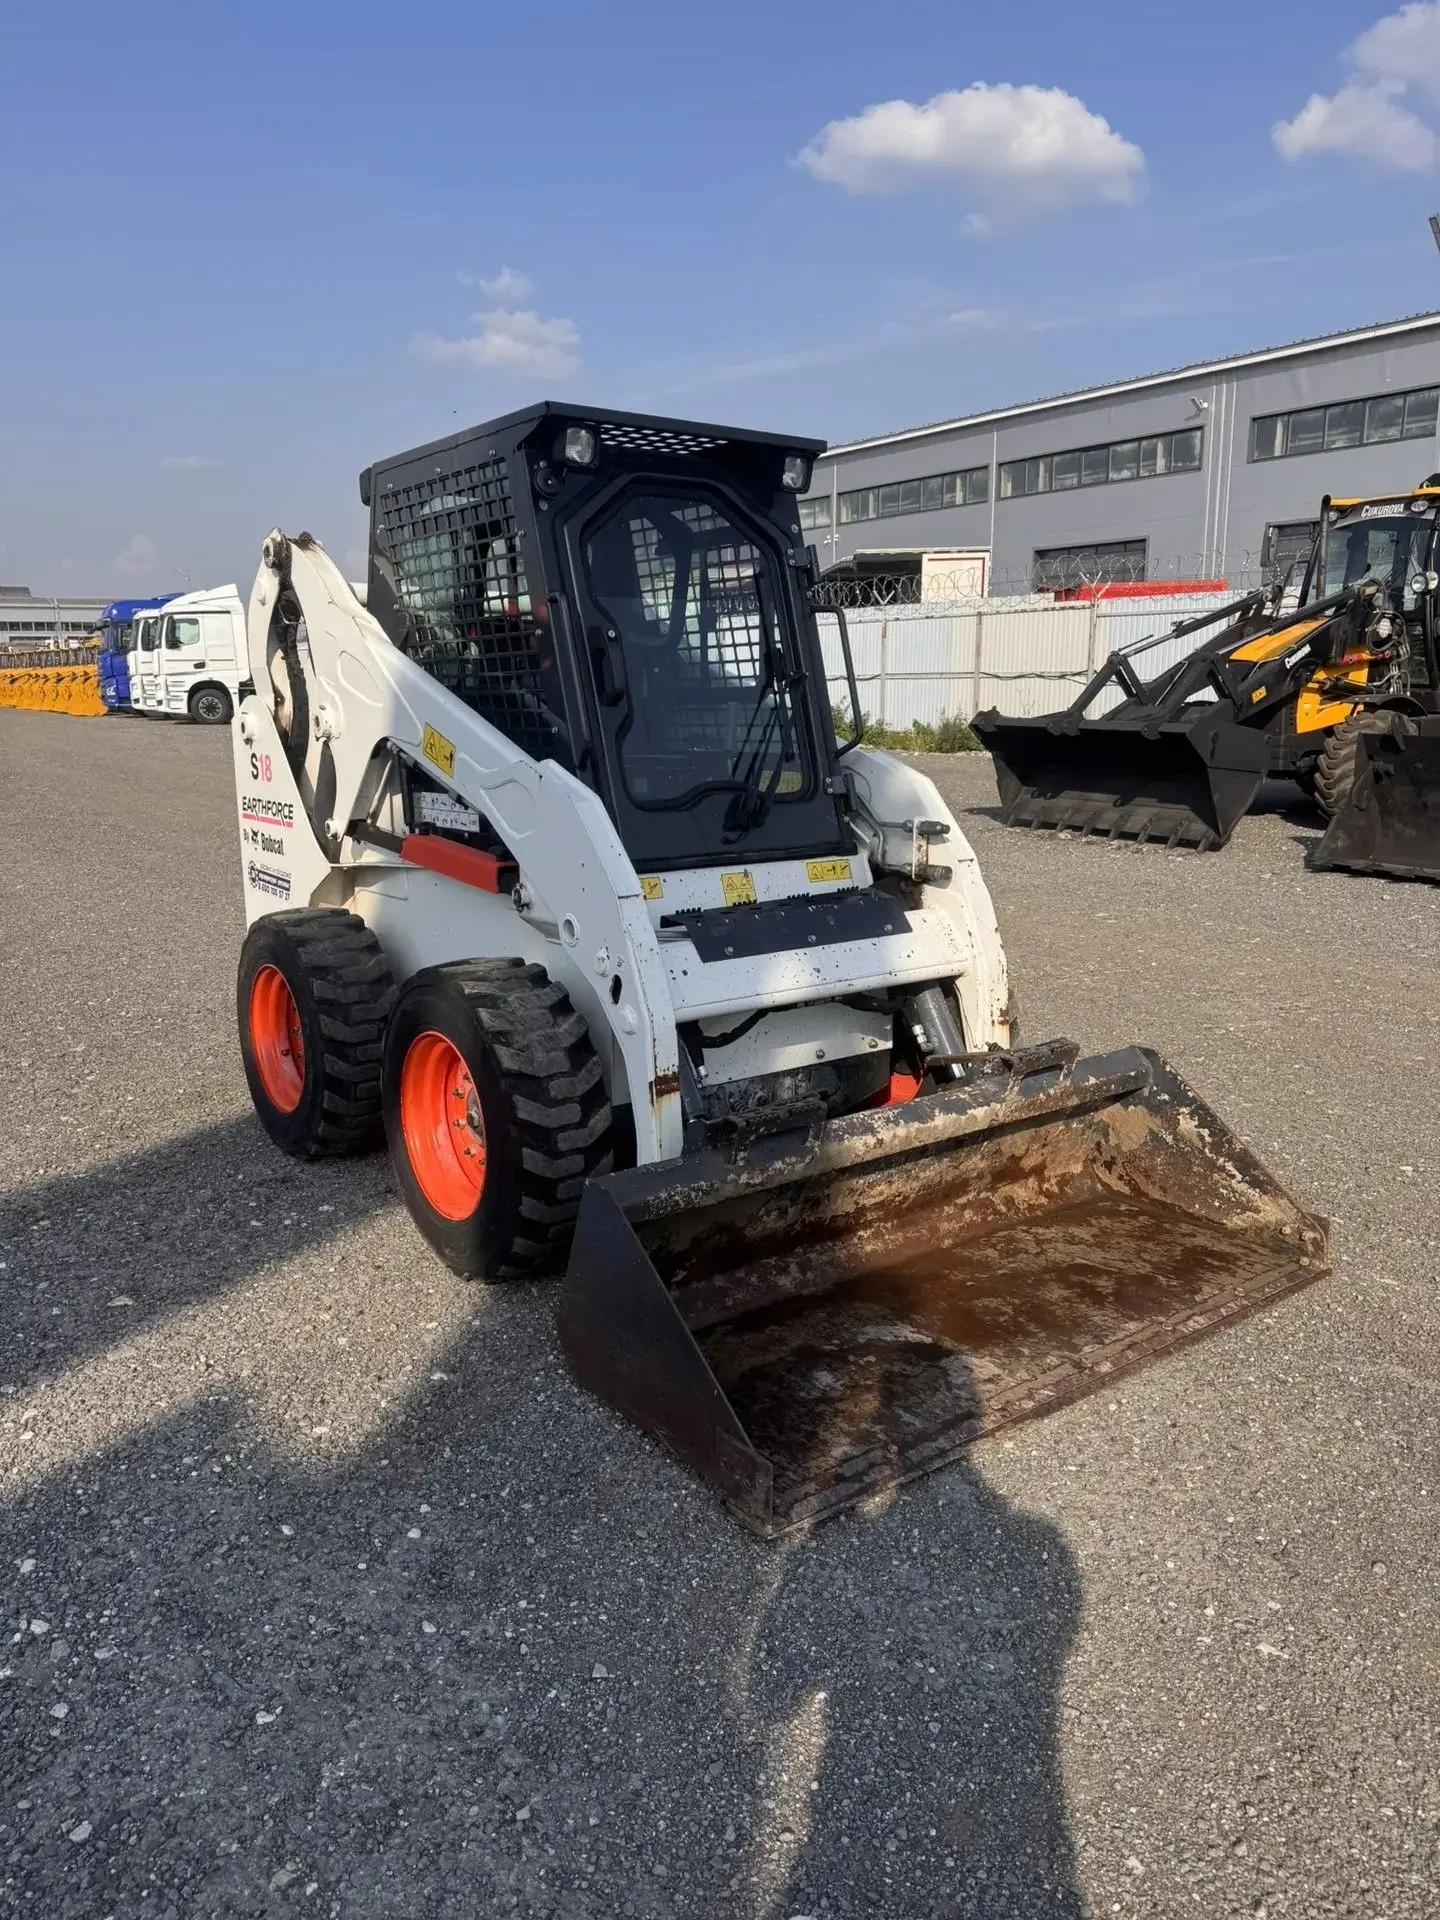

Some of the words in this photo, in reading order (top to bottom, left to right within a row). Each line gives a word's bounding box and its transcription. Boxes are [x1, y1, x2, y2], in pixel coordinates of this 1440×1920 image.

[250, 752, 272, 782] S18
[242, 796, 293, 824] EARTHFORCE
[261, 832, 284, 856] Bobcat
